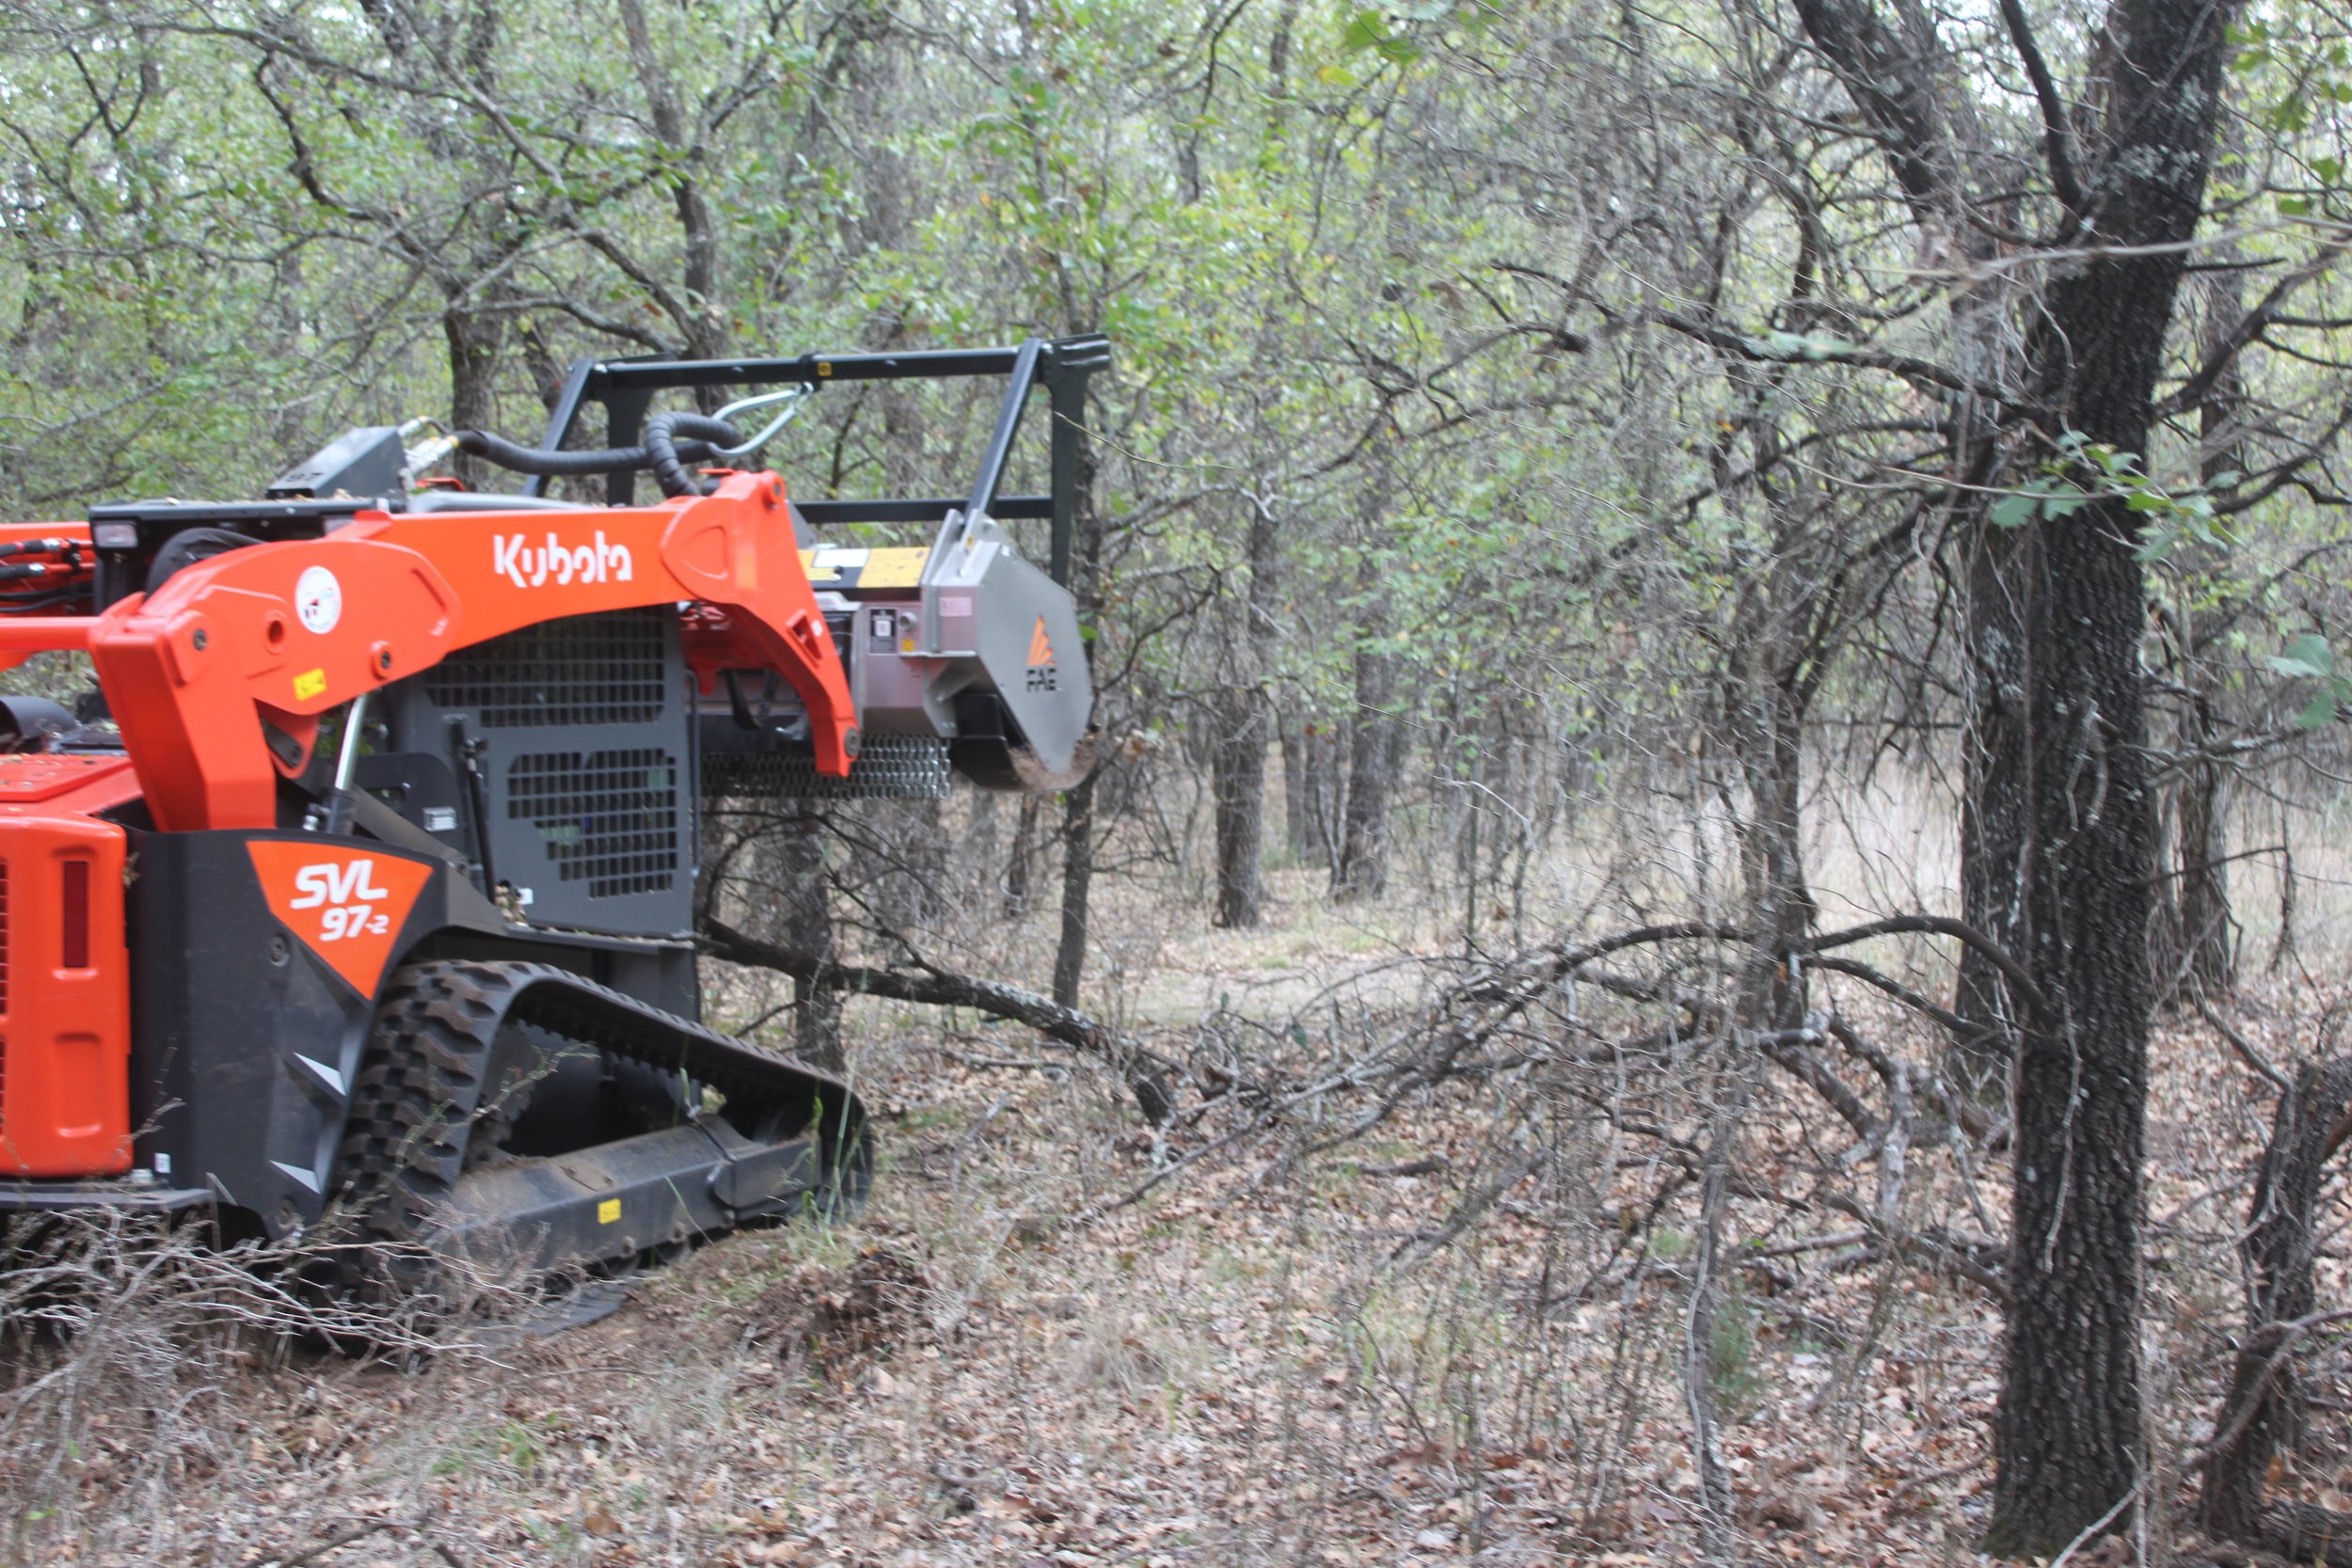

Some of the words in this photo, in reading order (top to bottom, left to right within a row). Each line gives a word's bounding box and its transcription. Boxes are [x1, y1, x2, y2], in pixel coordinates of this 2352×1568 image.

[494, 531, 632, 588] Kubota
[290, 859, 389, 910] SVL
[319, 904, 389, 942] 97-2
